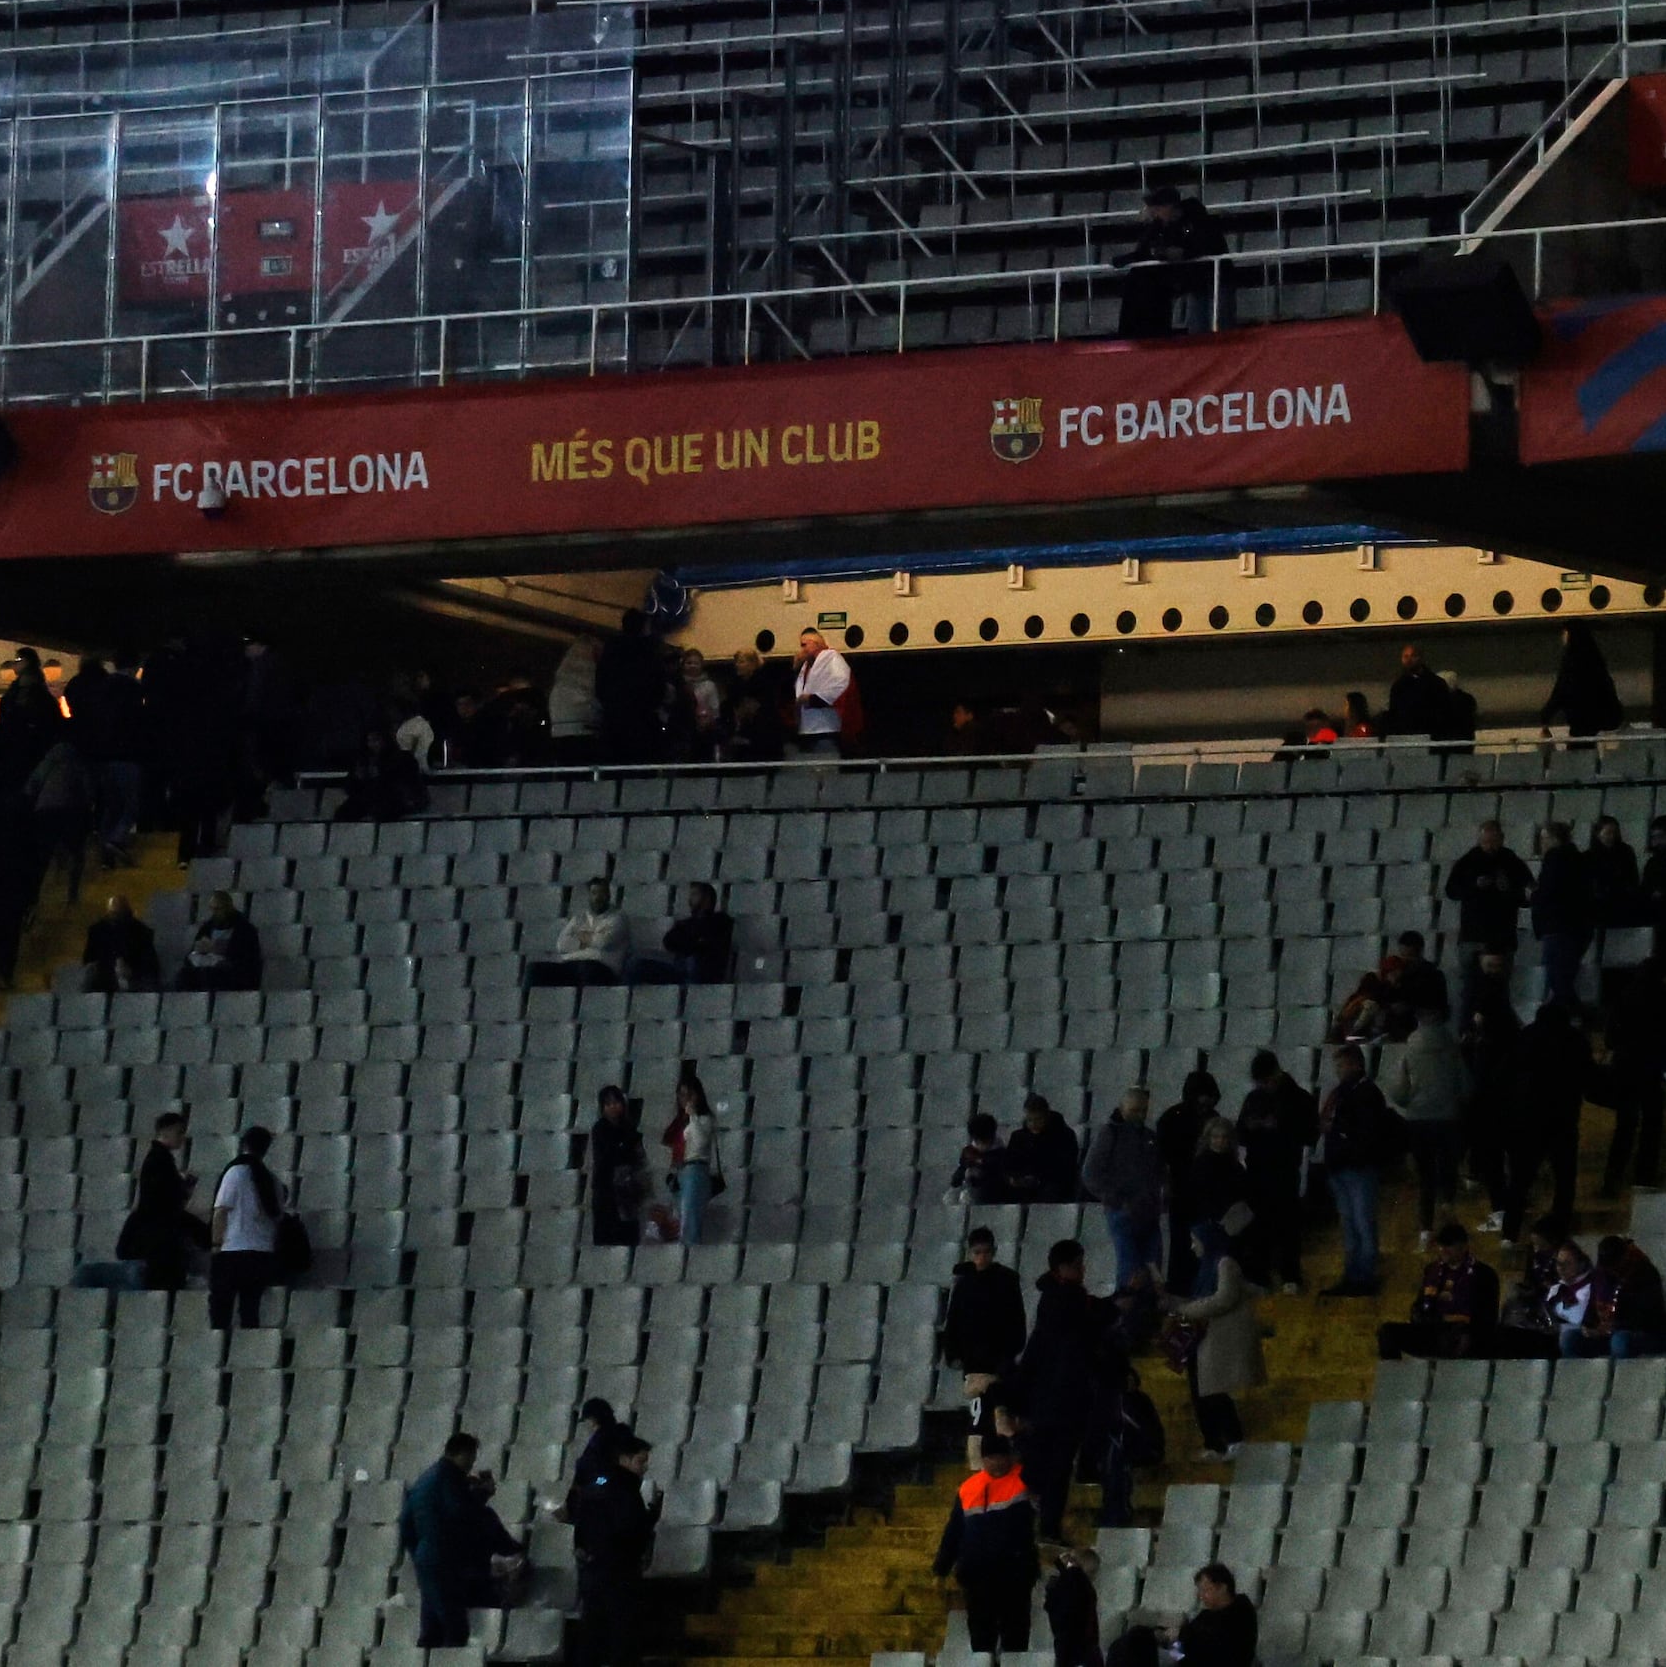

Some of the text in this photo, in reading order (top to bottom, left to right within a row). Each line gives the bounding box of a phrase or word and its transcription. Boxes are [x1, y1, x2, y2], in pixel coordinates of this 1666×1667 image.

[1059, 383, 1352, 448] FC BARCELONA
[153, 463, 193, 502] FC
[531, 420, 881, 485] MÉS QUE UN CLUB
